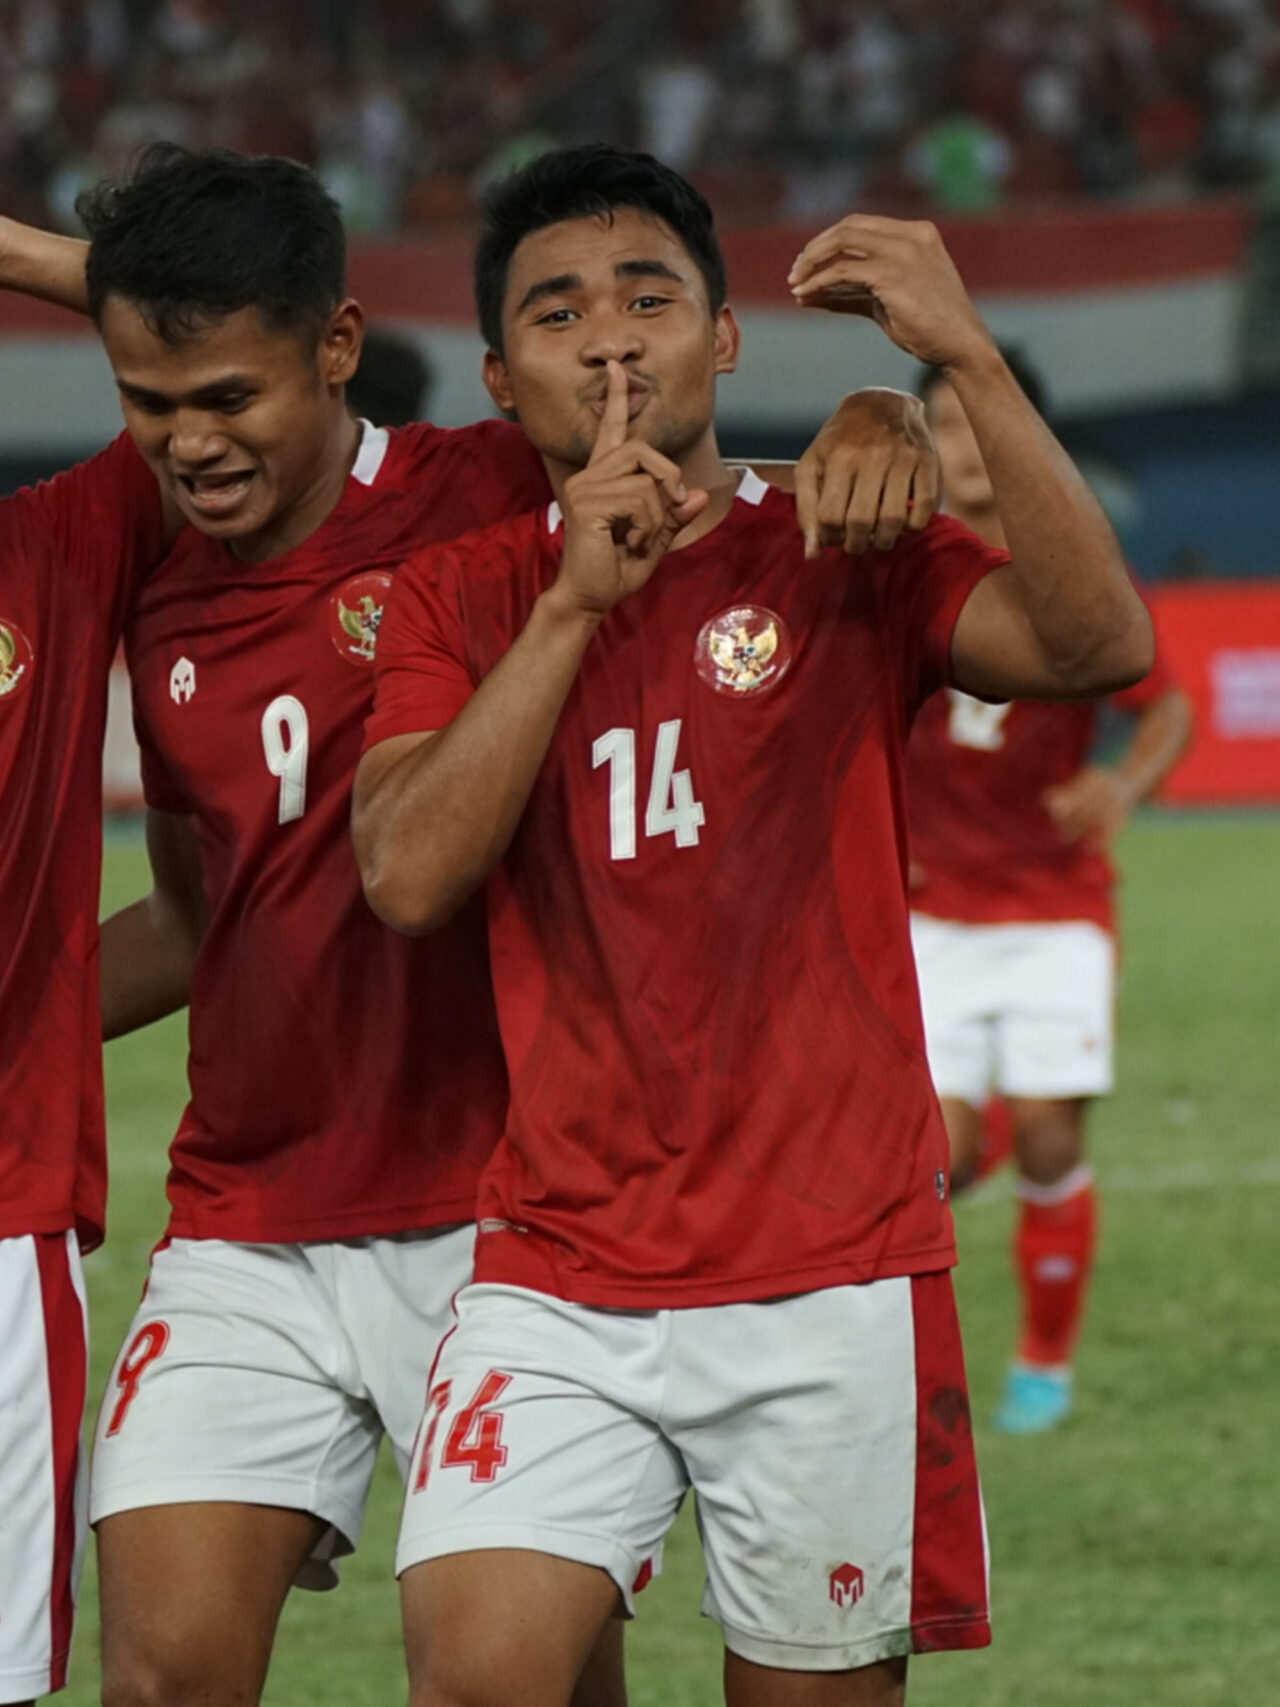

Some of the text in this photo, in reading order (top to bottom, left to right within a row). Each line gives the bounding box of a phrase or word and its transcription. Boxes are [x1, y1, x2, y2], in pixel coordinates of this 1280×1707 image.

[260, 694, 310, 825] 9
[591, 717, 707, 861] 14
[104, 1319, 170, 1439] 9
[412, 1368, 514, 1496] 14
